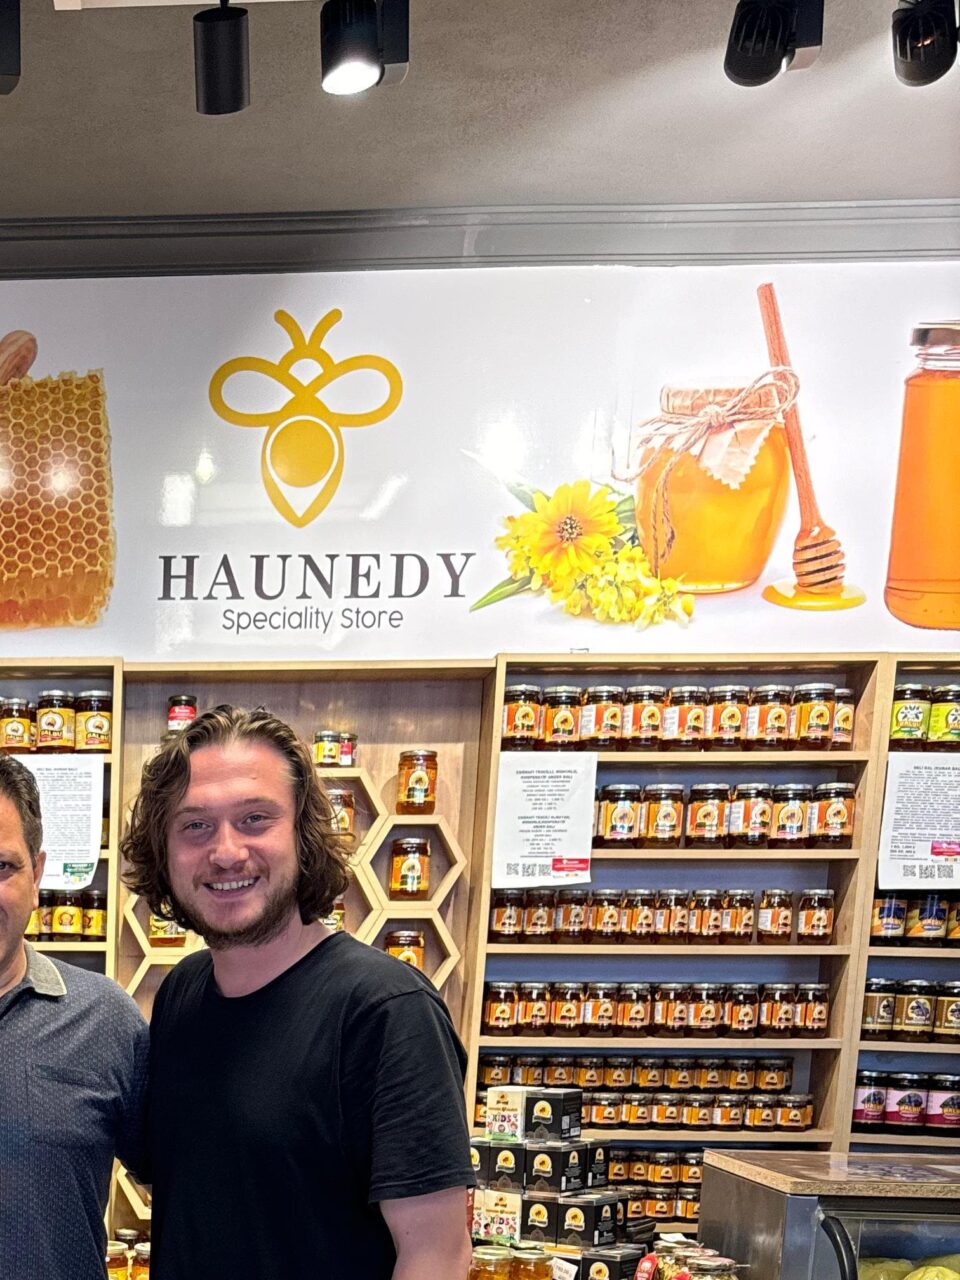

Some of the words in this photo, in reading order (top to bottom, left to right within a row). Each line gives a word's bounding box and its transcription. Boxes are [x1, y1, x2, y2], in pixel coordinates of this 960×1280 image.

[157, 552, 476, 601] HAUNEDY
[222, 605, 333, 634] Speciality
[340, 606, 403, 629] Store
